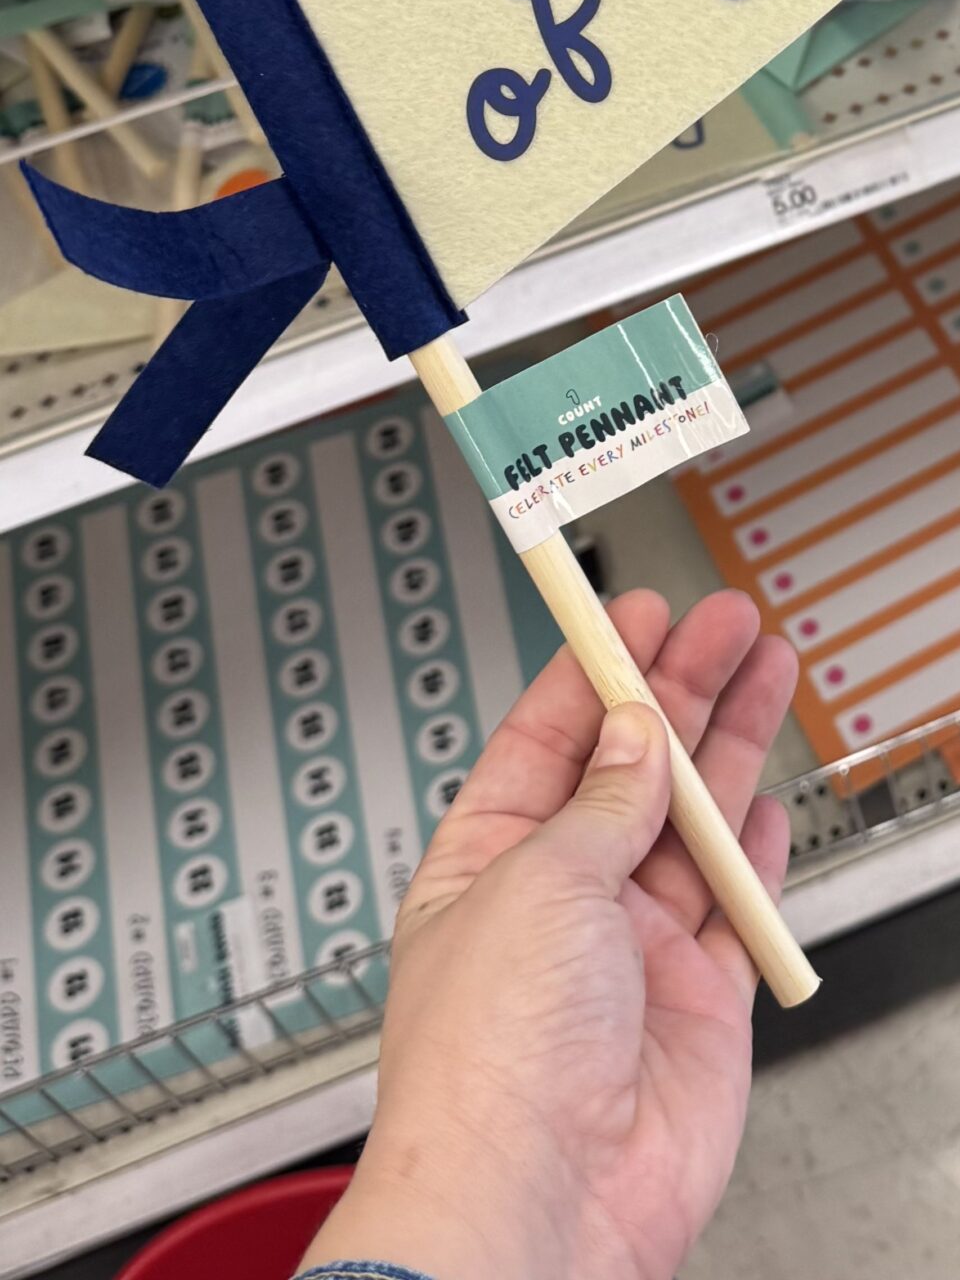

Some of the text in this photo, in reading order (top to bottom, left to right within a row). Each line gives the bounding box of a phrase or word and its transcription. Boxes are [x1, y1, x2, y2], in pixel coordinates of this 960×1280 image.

[772, 185, 817, 216] 5.00
[557, 395, 602, 426] COUNT
[504, 375, 688, 491] FELT PENNANT
[578, 444, 624, 477] EVERY
